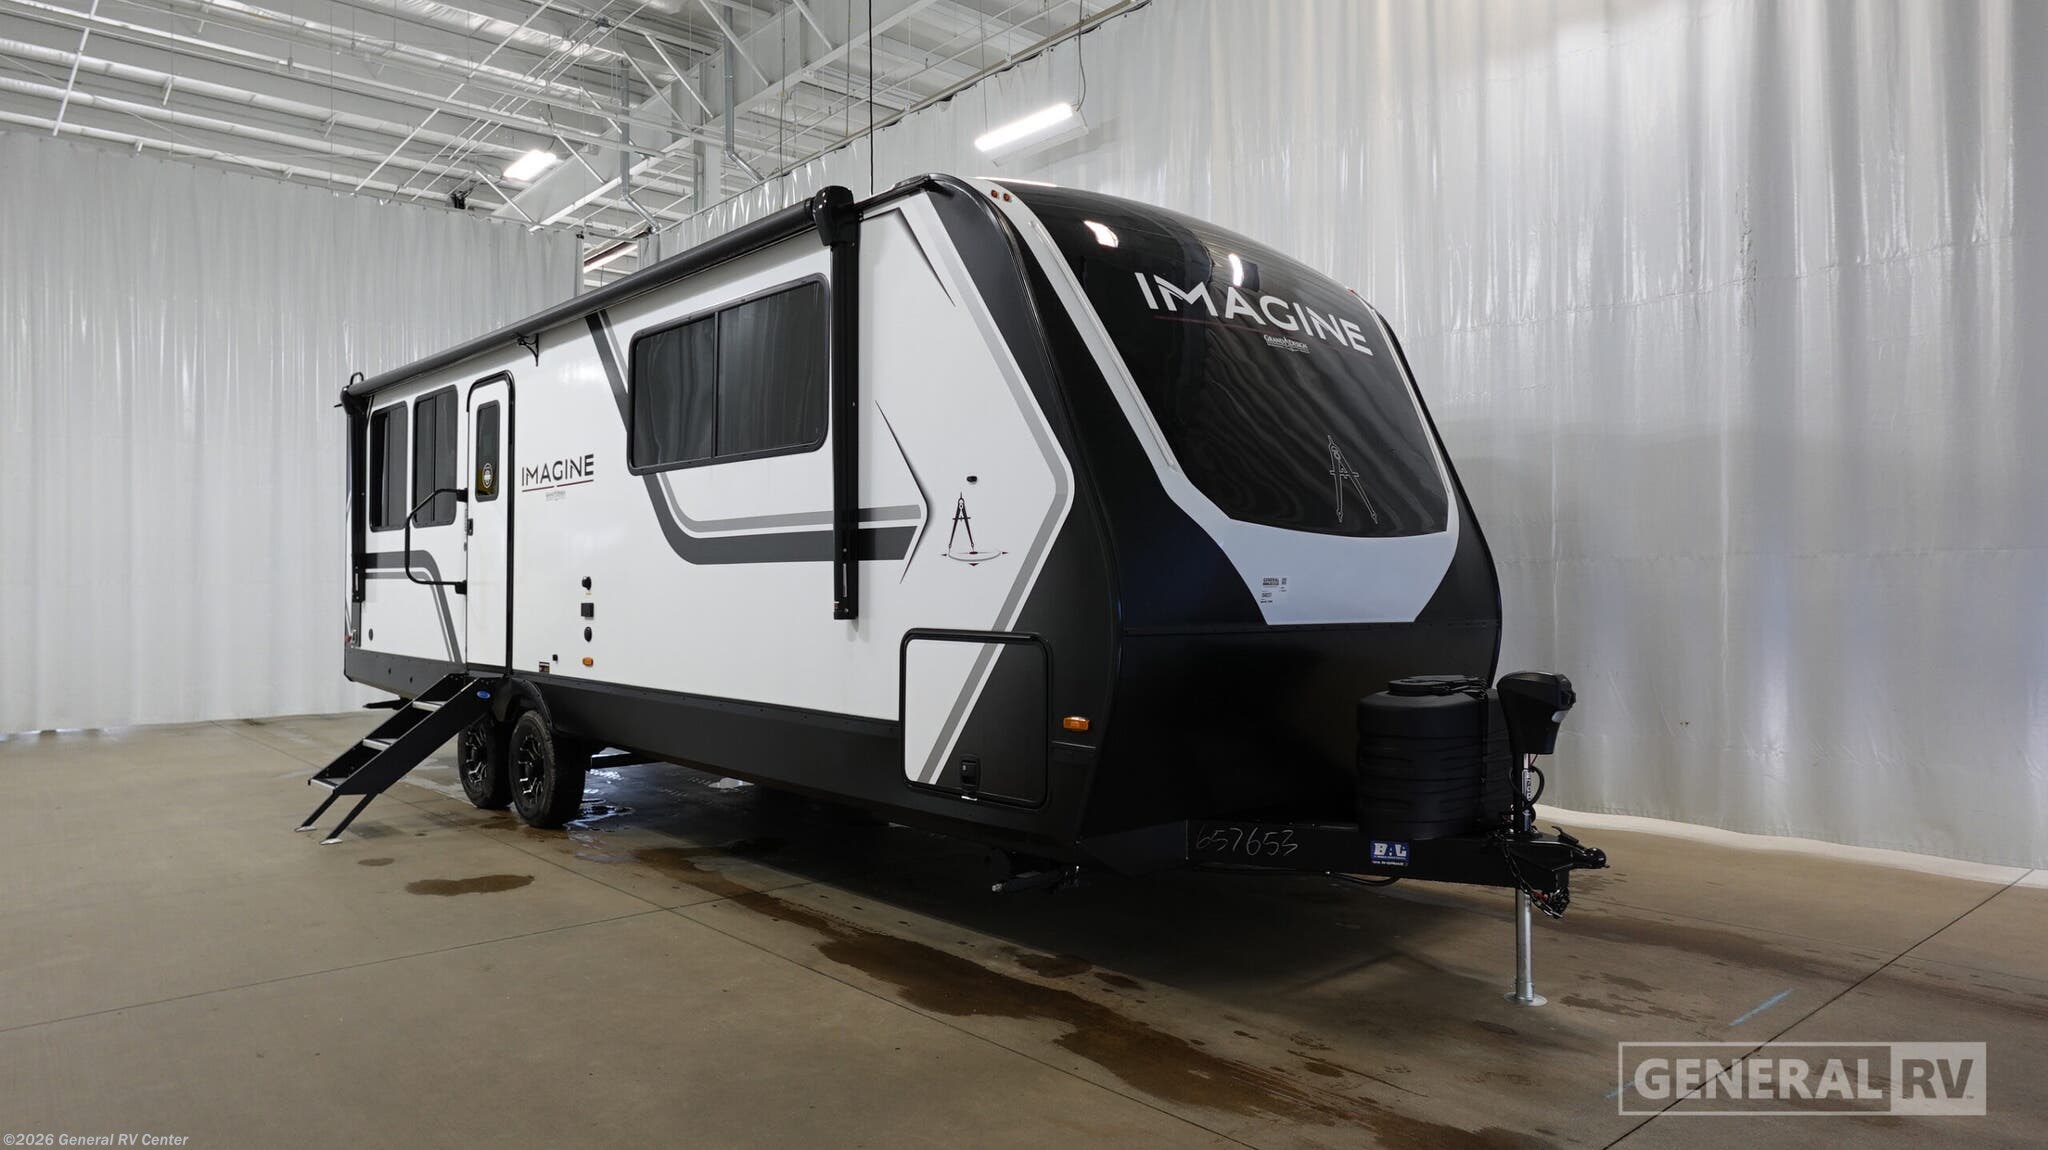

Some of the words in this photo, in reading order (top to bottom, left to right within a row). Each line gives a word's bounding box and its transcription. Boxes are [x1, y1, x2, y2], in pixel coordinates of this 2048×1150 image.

[1135, 272, 1373, 356] IMAGINE
[522, 453, 594, 486] IMAGINE
[1196, 824, 1298, 856] 657653
